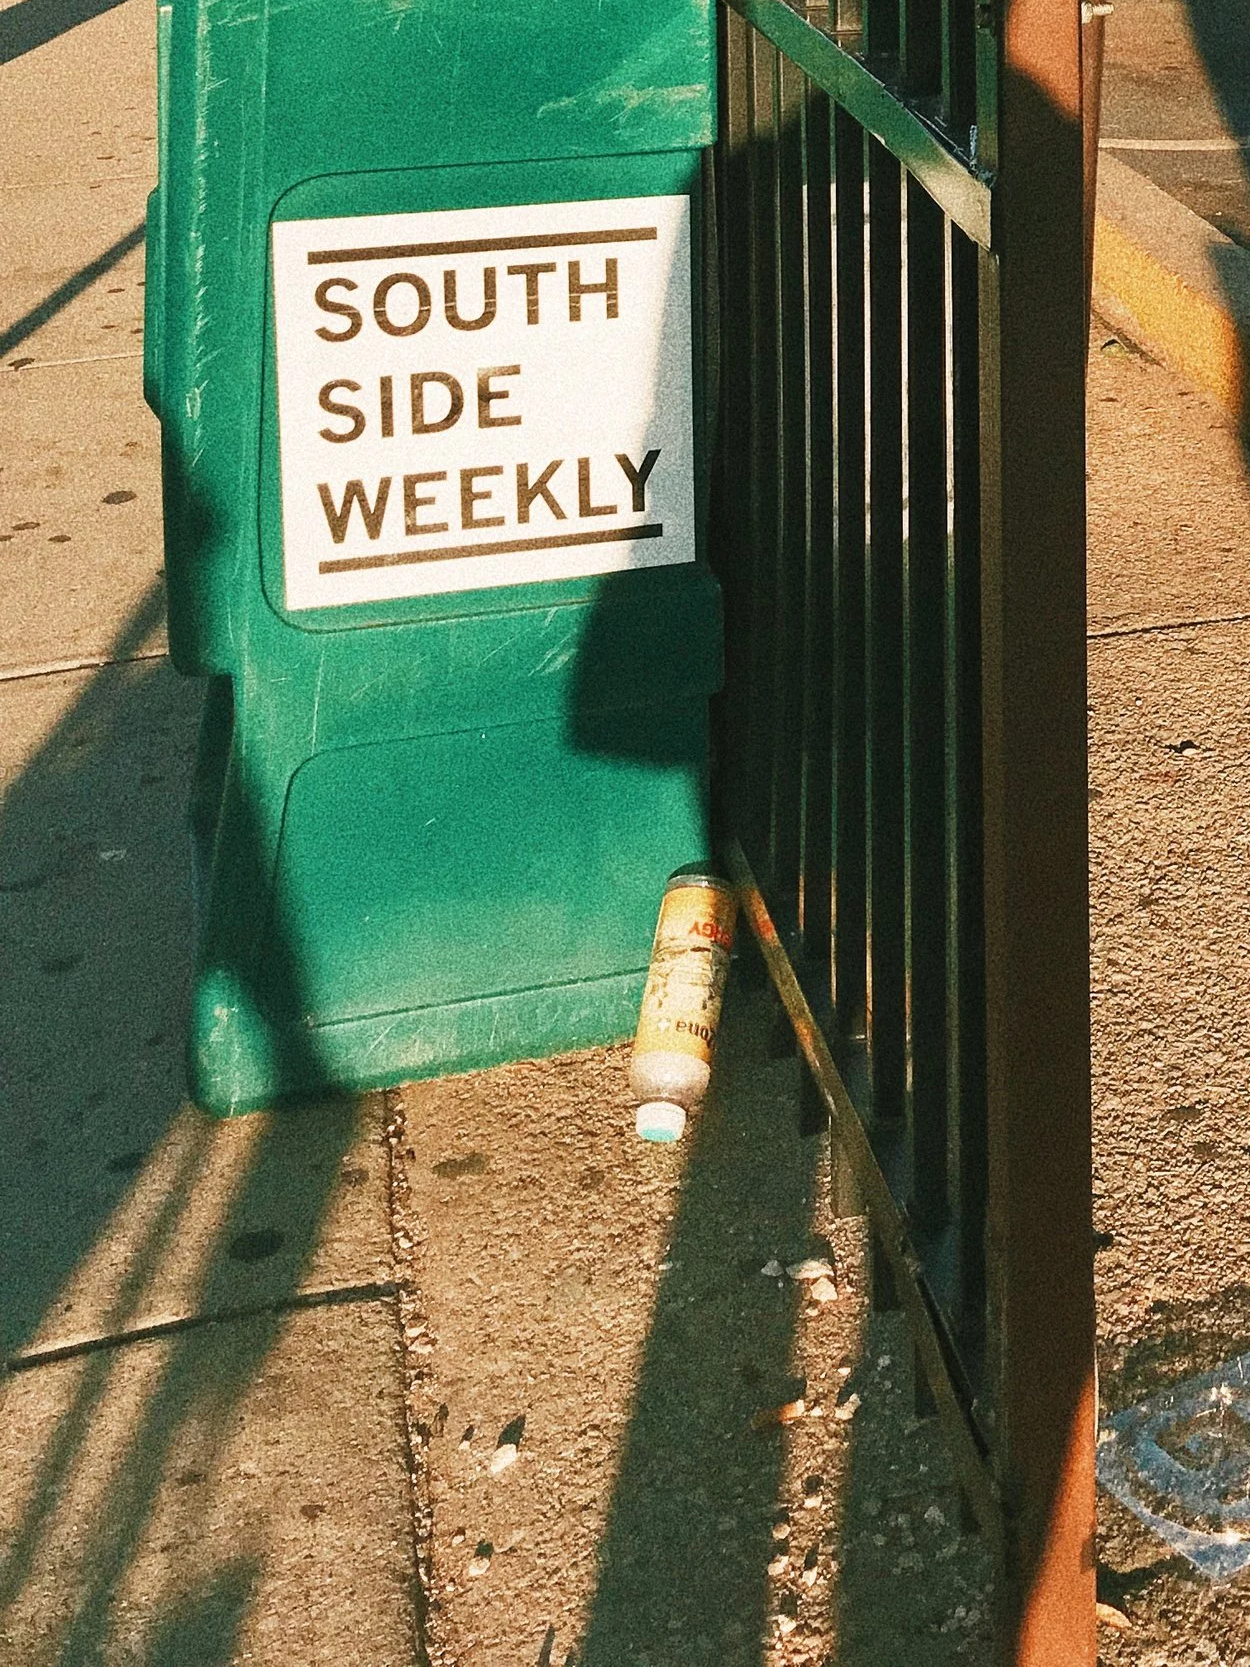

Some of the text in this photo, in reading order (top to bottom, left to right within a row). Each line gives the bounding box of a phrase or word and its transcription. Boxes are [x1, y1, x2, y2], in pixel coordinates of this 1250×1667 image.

[314, 257, 619, 343] SOUTH
[317, 364, 523, 444] SIDE
[316, 449, 662, 544] WEEKLY
